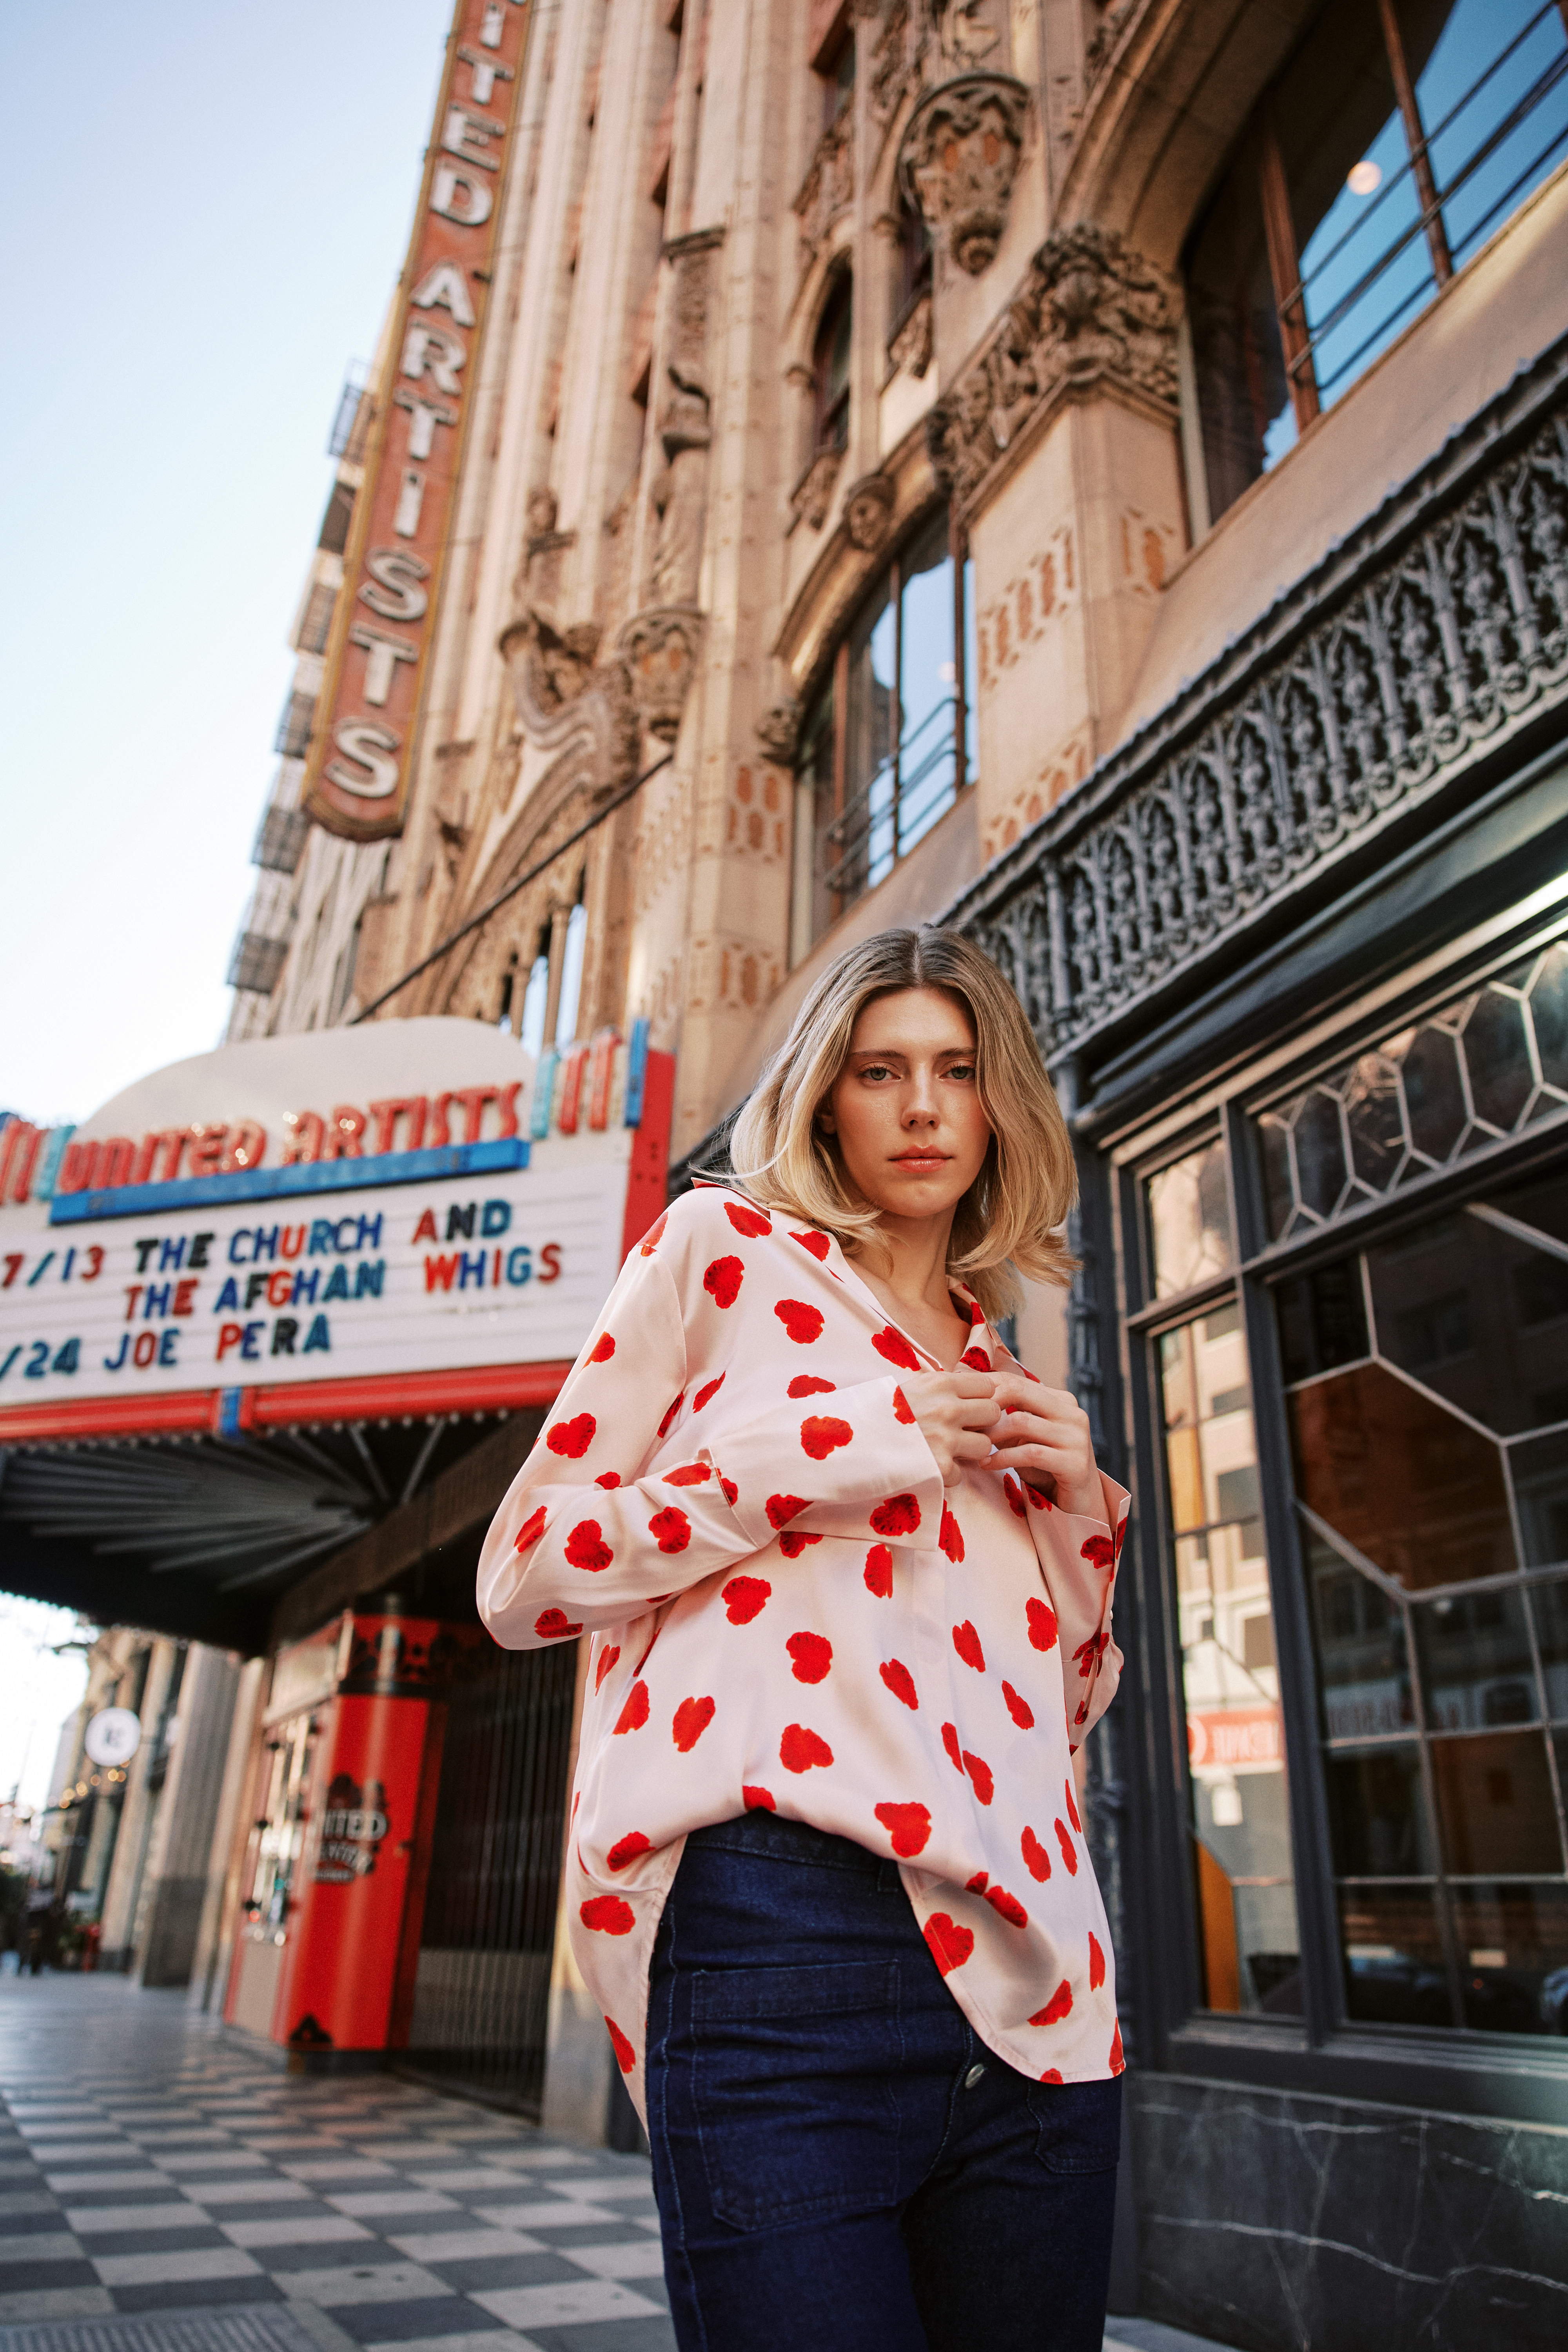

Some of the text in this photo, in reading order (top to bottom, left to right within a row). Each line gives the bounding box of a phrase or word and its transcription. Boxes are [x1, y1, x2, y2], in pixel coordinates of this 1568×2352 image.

[325, 0, 526, 799] ITED ARTISTS
[58, 1082, 522, 1195] UNITED ARTISTS
[1, 1199, 512, 1288] 7/13 THE CHURCH AND
[124, 1242, 563, 1321] THE AFGHAN WHIGS
[104, 1327, 181, 1372] JOE
[214, 1314, 330, 1361] PERA
